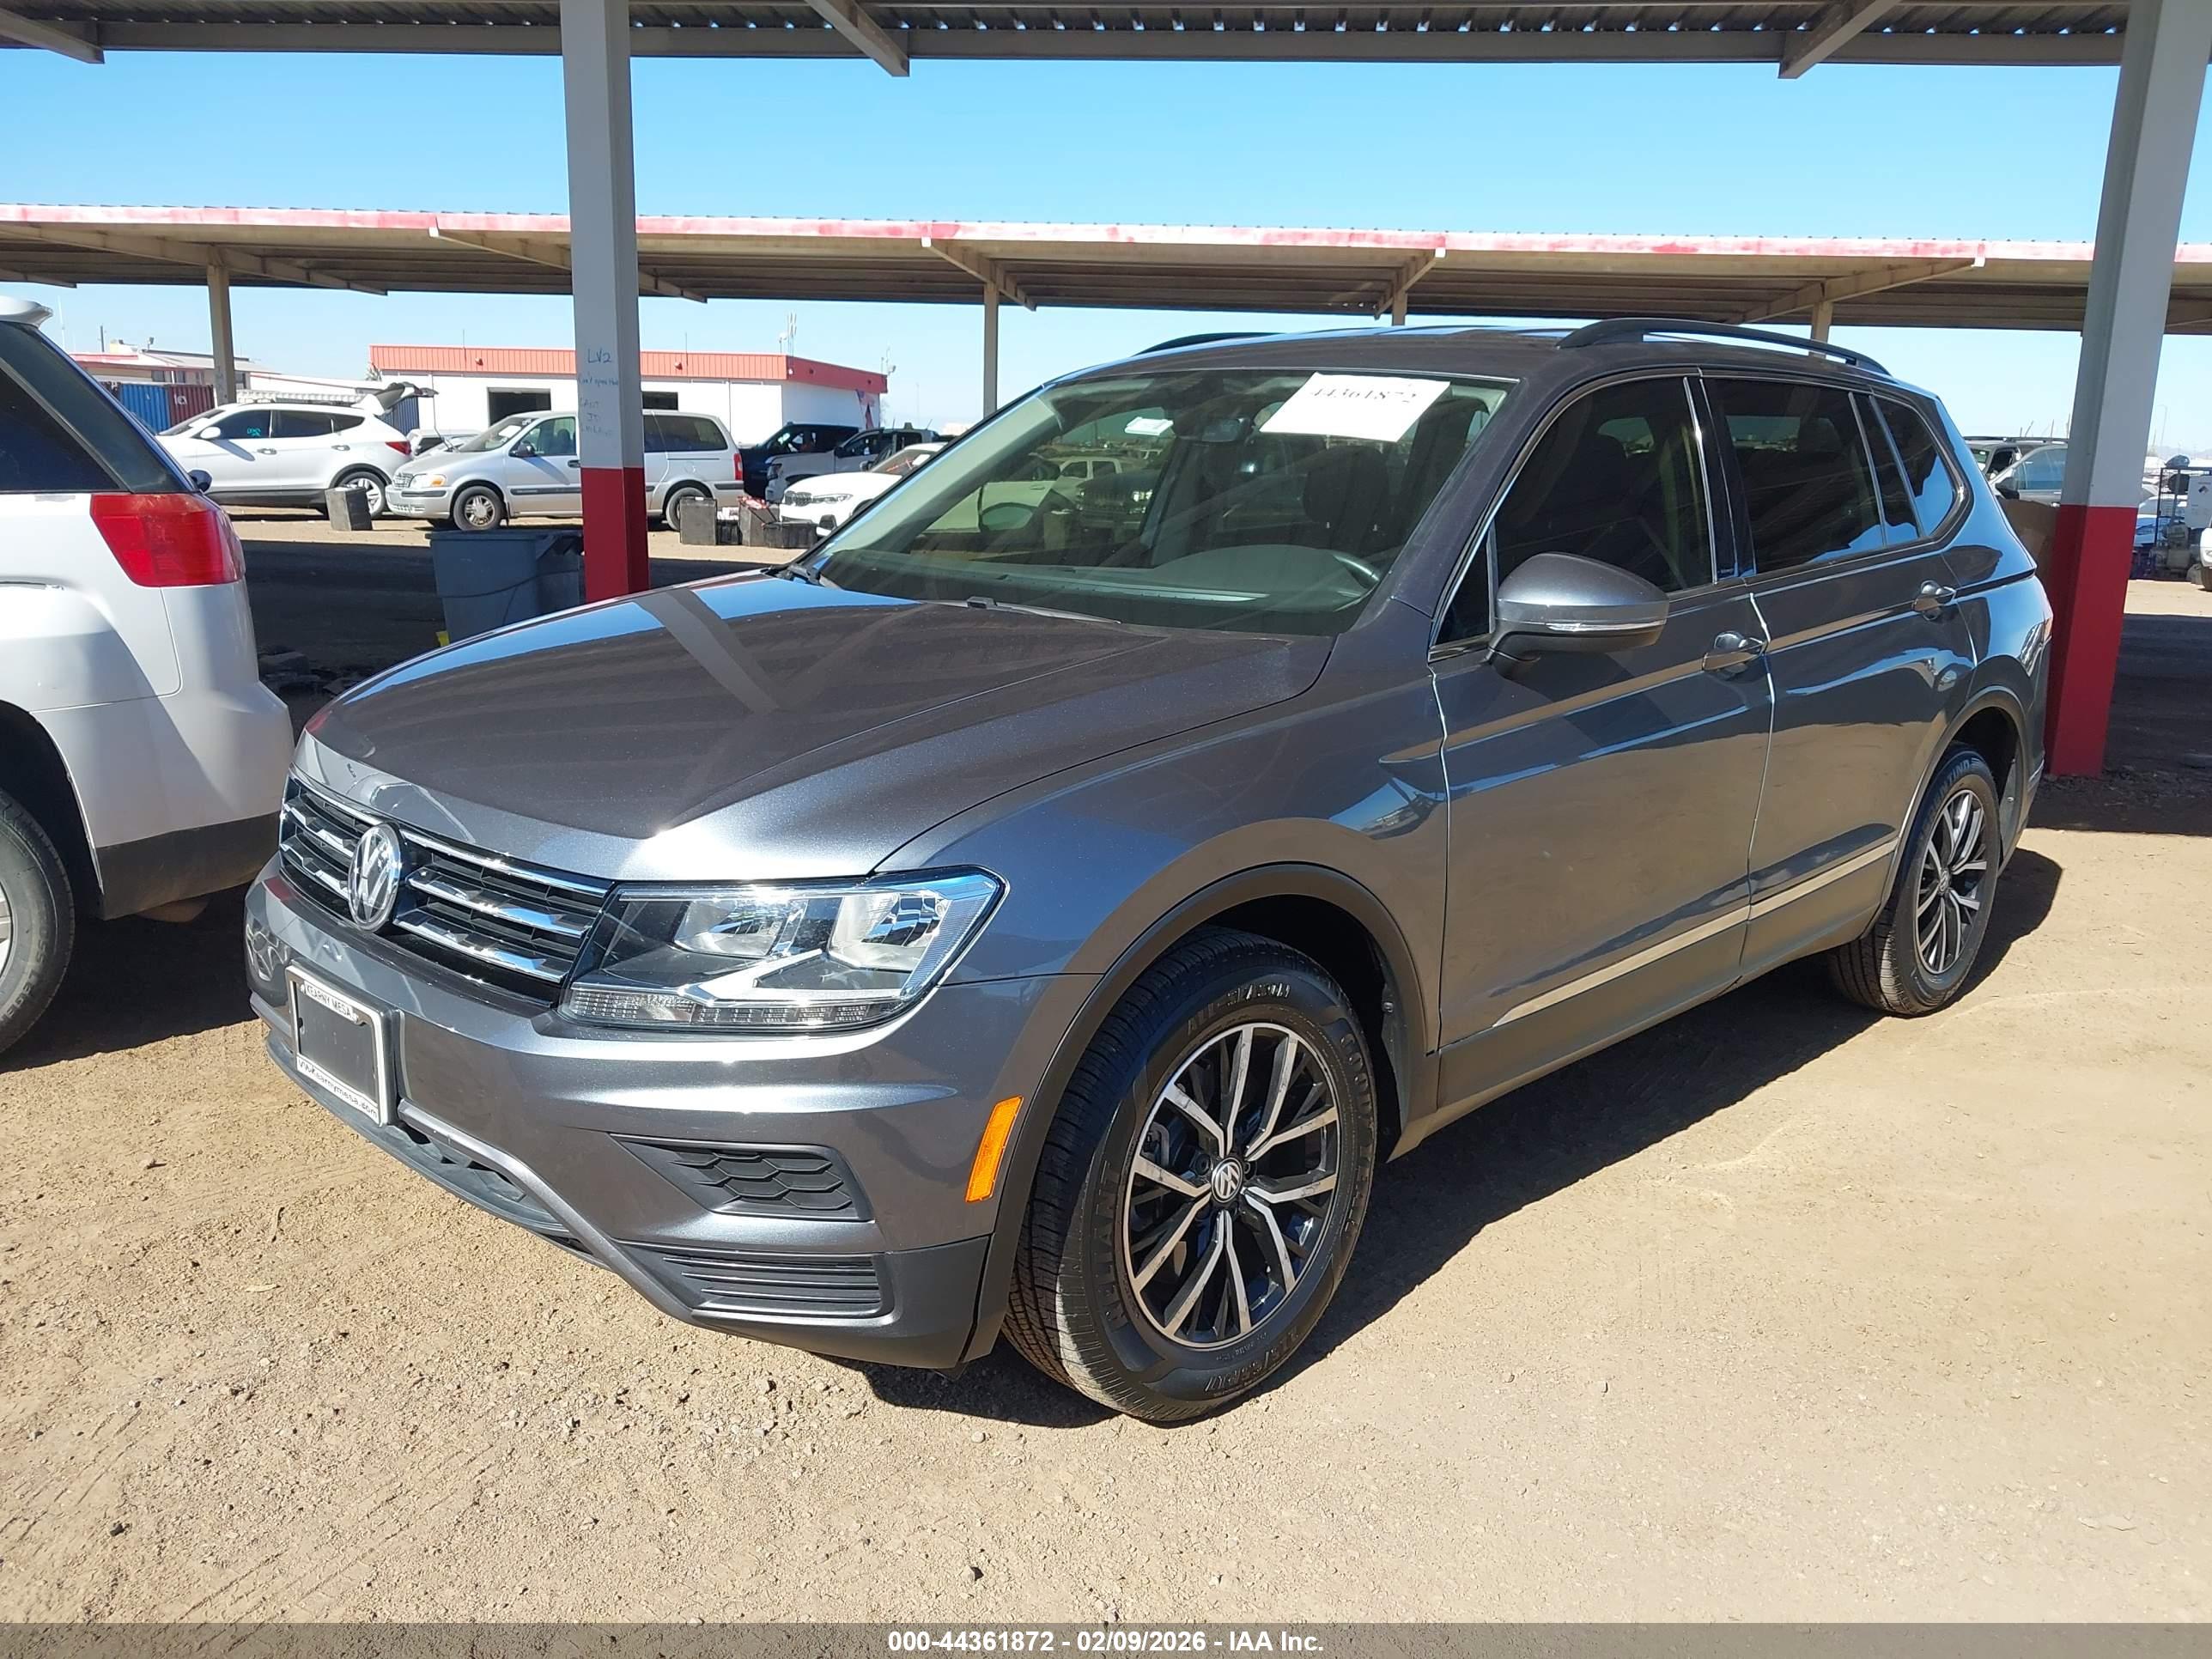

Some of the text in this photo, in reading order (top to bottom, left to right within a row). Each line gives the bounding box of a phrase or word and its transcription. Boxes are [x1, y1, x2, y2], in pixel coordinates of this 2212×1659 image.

[587, 347, 612, 364] LV2
[307, 984, 351, 1017] KEARNY MESA
